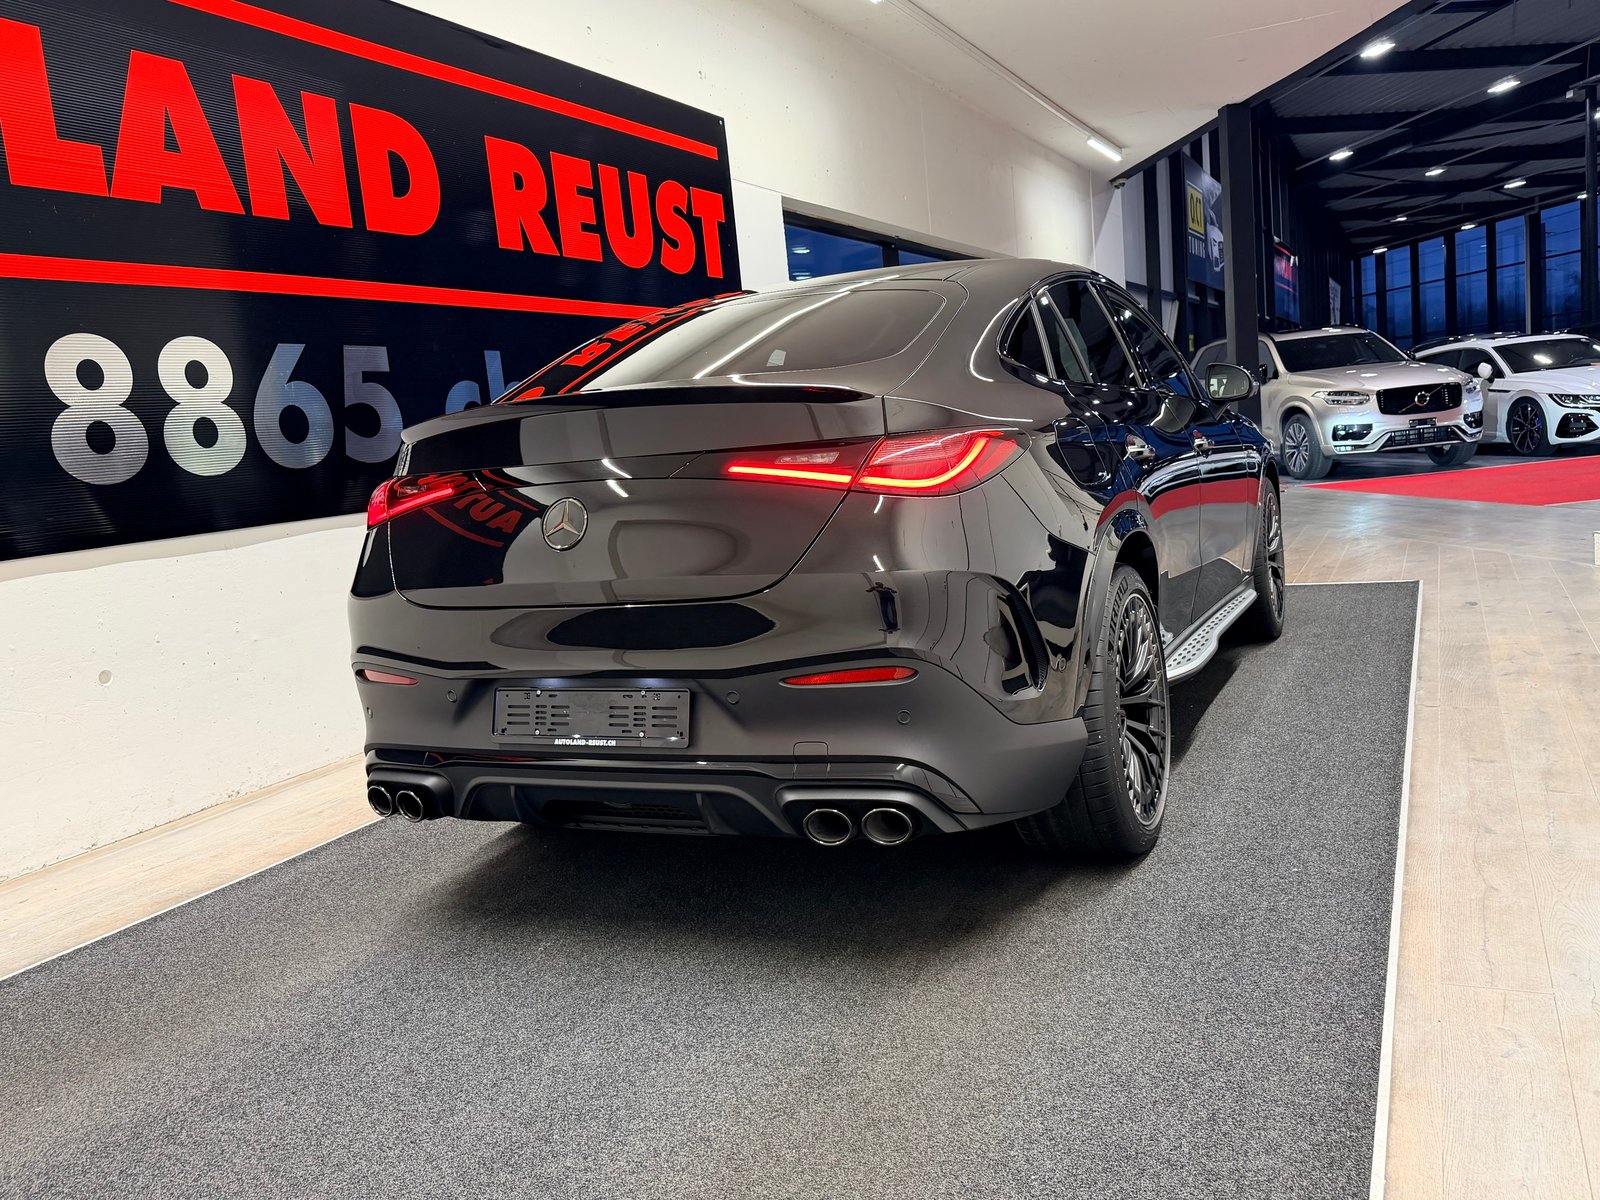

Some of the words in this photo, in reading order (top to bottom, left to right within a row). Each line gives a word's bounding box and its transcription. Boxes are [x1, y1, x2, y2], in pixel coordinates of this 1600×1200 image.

[485, 136, 725, 279] REUST
[44, 332, 404, 486] 8865
[553, 738, 617, 746] AUTOLAND-REUST.CH
